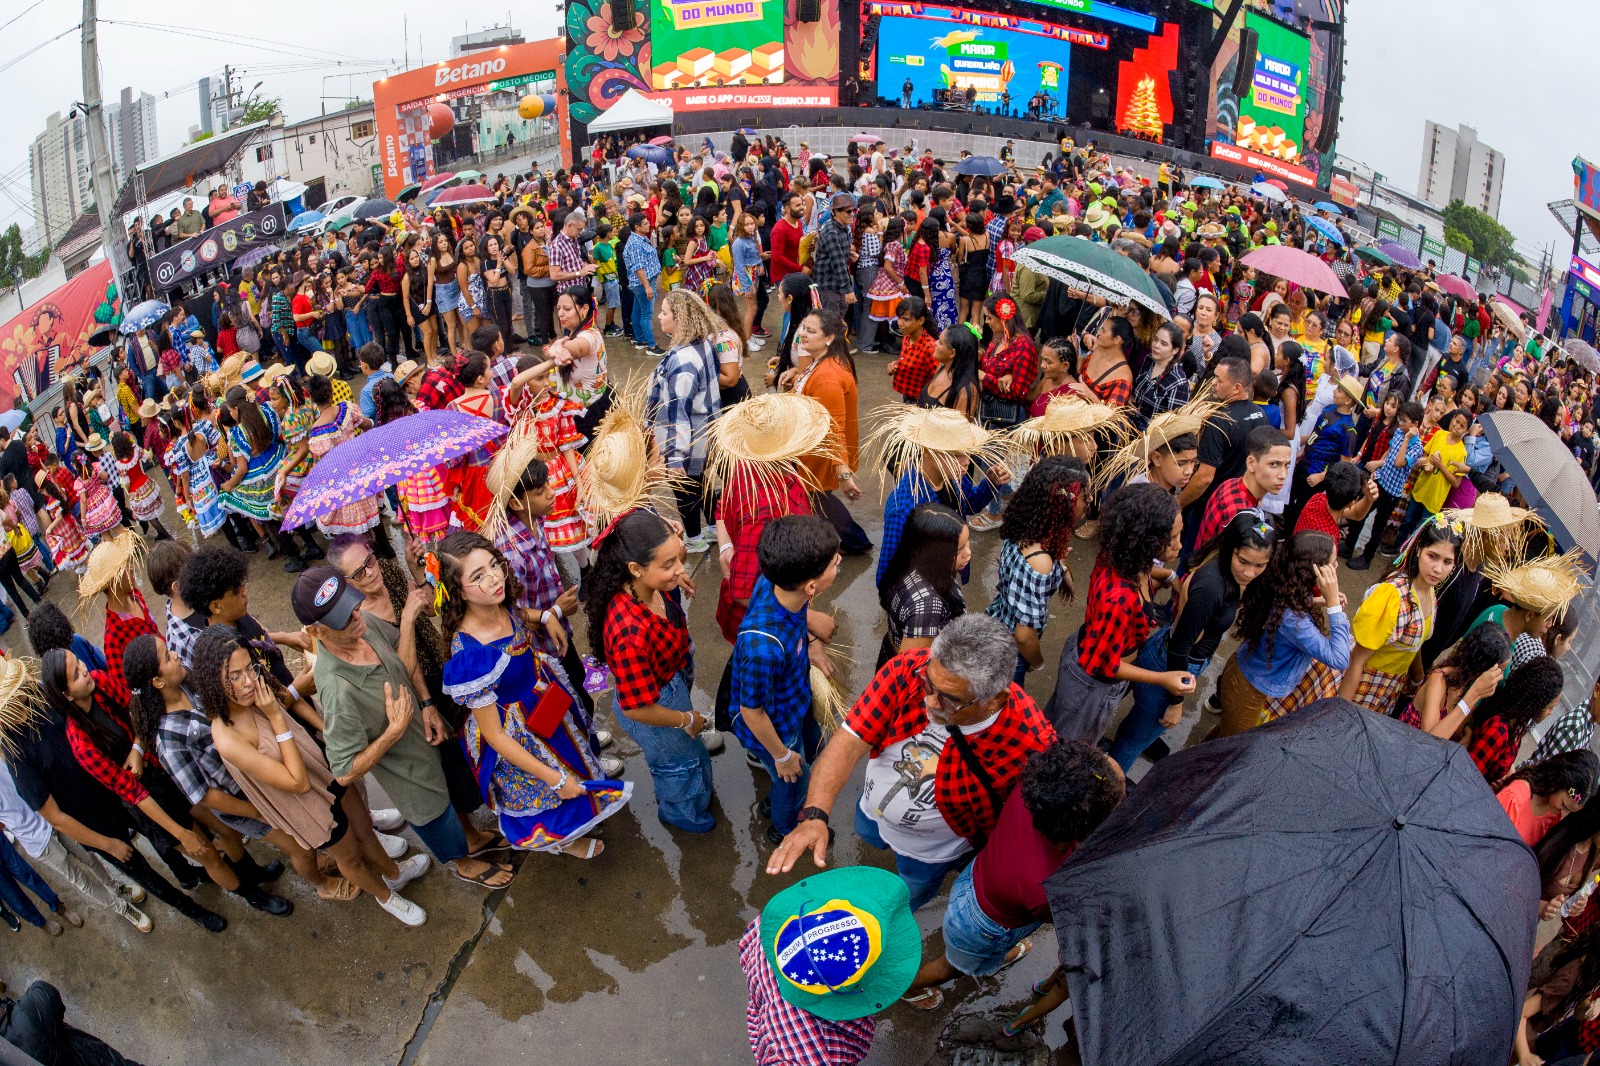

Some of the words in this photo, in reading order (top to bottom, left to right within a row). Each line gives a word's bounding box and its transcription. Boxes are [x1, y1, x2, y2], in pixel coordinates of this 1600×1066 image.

[682, 8, 700, 20] DO
[705, 2, 753, 17] MUNDO
[961, 44, 995, 55] MAIOR
[434, 58, 506, 87] Betano
[1265, 58, 1290, 76] MAIOR
[493, 77, 520, 90] POSTO
[522, 72, 555, 83] MÉDICO
[401, 101, 423, 112] SAÍDA
[708, 95, 717, 104] O
[717, 94, 733, 103] APP
[734, 95, 747, 103] OU
[748, 95, 772, 104] ACESSE
[1258, 92, 1267, 101] DO
[1270, 95, 1292, 108] MUNDO
[385, 135, 398, 177] Betano
[1215, 145, 1242, 160] Betano
[1381, 221, 1398, 233] SAÍDA
[1425, 240, 1443, 253] SAÍDA
[160, 267, 172, 279] 01
[781, 941, 802, 961] ORDEM
[807, 918, 858, 940] PROGRESSO
